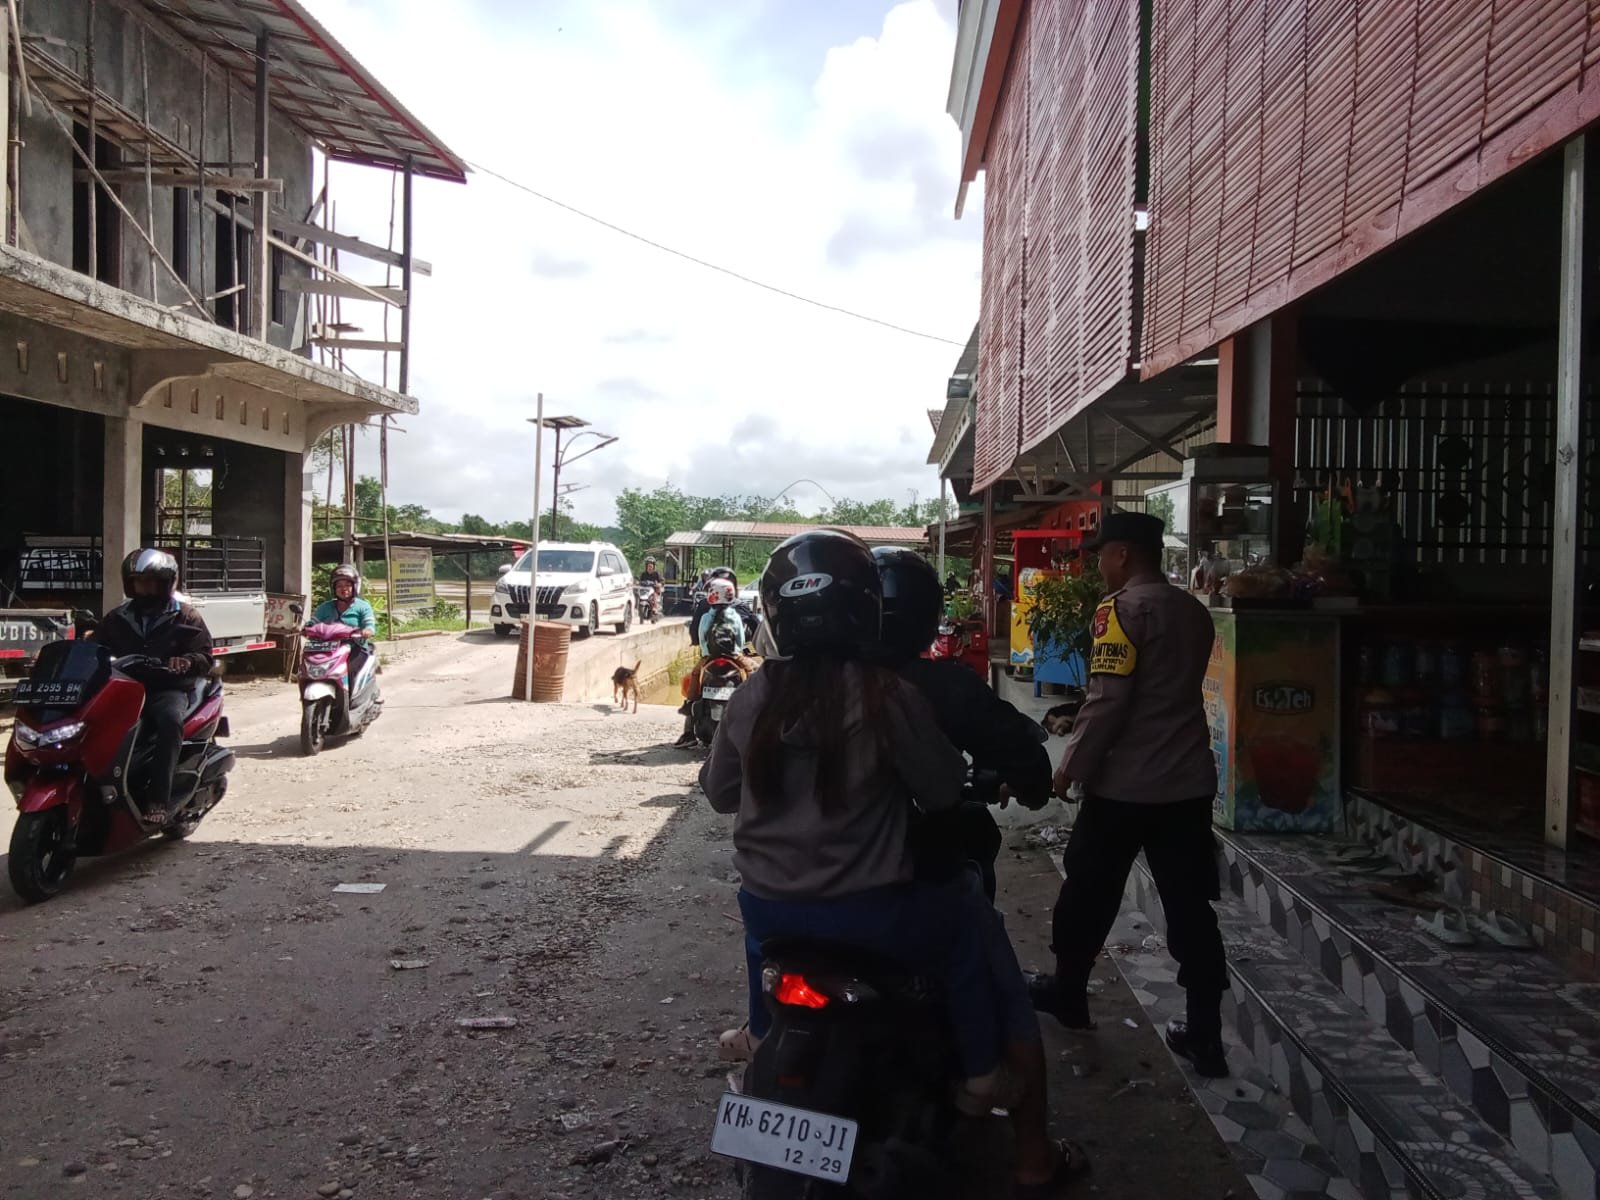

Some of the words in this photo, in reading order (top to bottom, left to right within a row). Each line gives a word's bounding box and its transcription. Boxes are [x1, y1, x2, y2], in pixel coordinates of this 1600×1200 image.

[790, 578, 822, 590] GM
[1280, 686, 1312, 709] Teh
[722, 1101, 749, 1129] KH
[758, 1110, 811, 1142] 6210
[822, 1124, 849, 1152] JI
